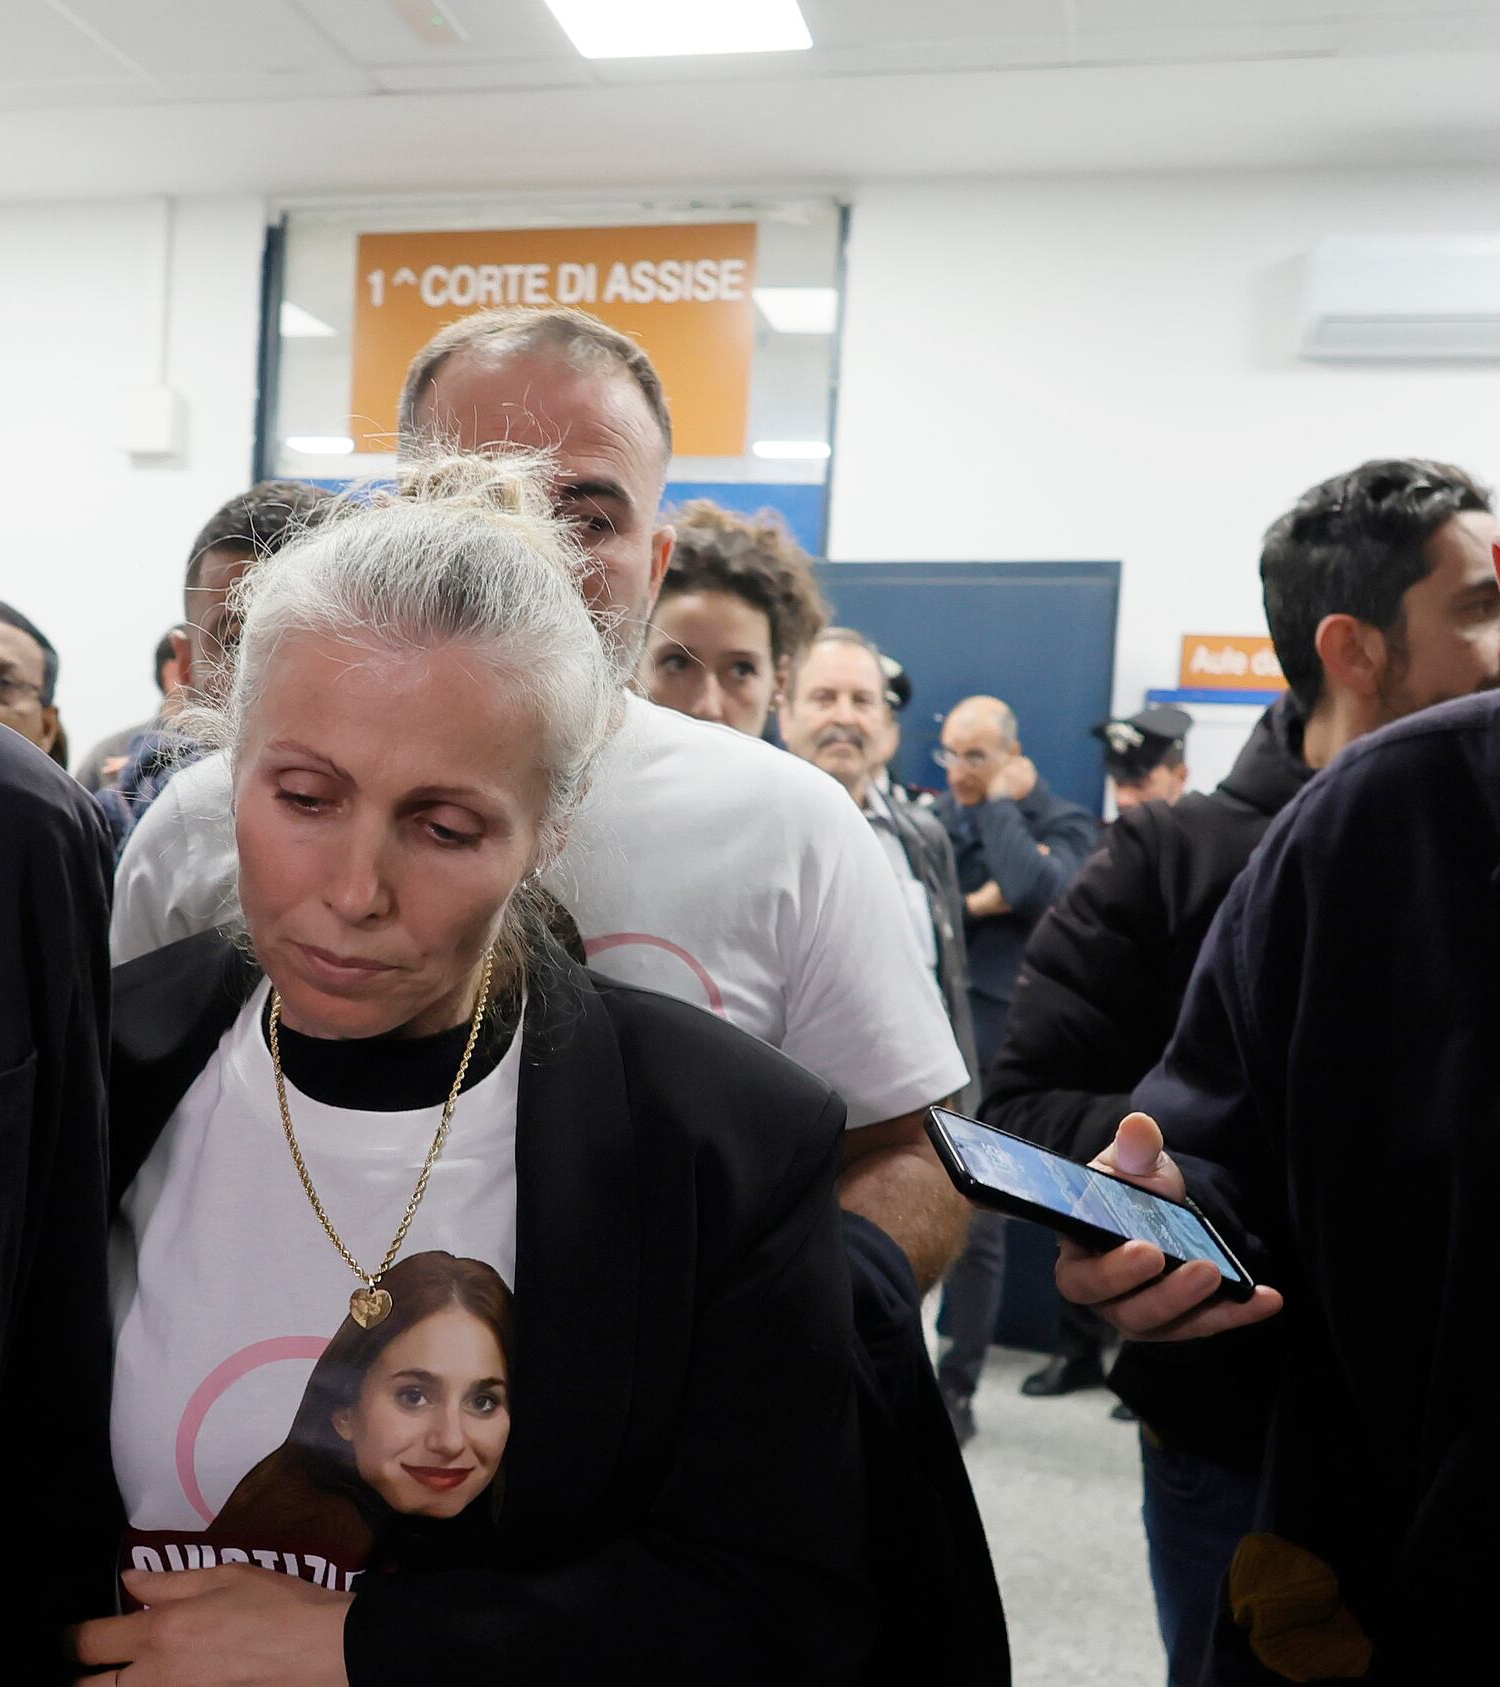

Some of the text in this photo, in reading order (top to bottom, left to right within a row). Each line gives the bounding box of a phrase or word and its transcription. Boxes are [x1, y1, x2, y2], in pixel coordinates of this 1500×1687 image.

[421, 263, 550, 307] CORTE
[556, 262, 597, 305] DI
[603, 258, 747, 304] ASSISE
